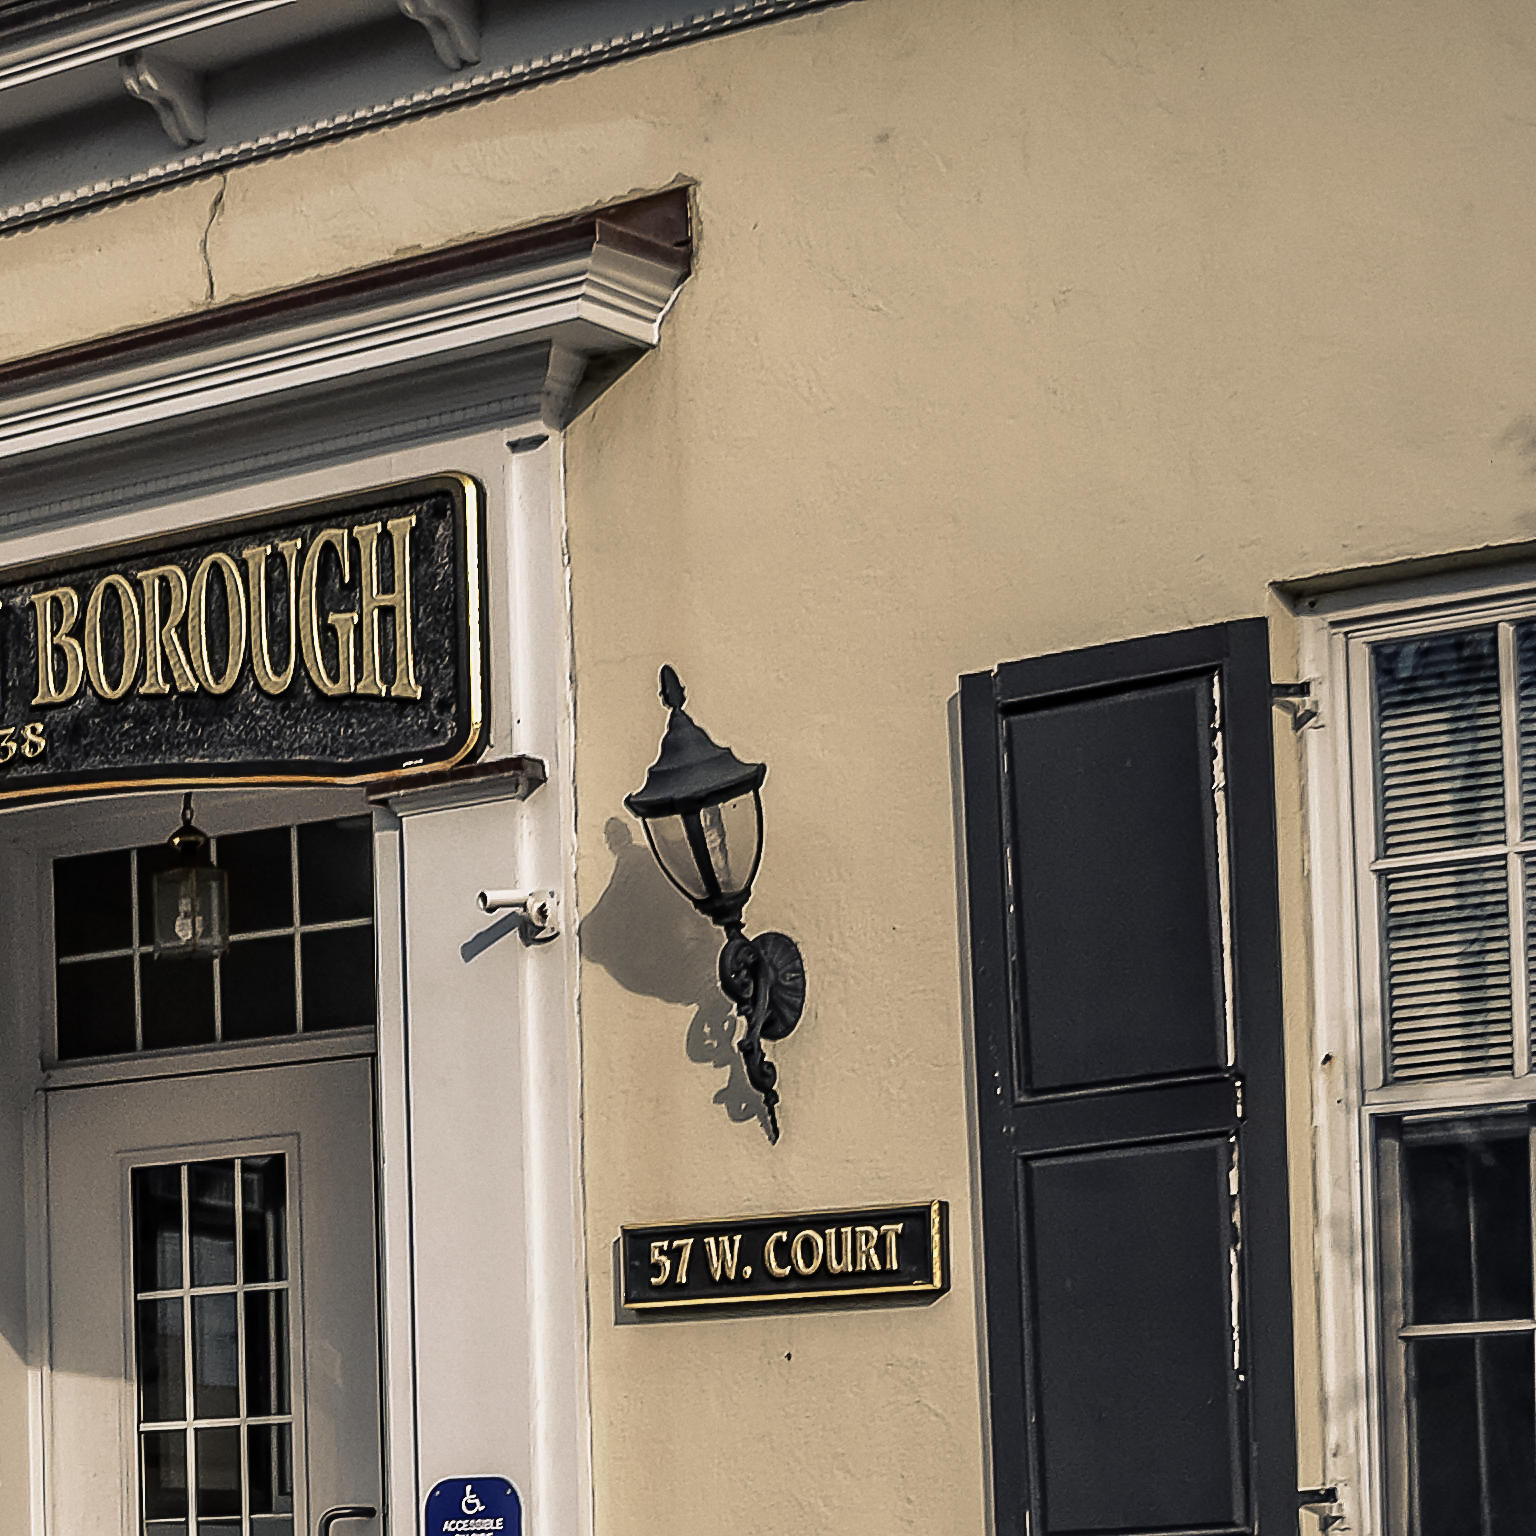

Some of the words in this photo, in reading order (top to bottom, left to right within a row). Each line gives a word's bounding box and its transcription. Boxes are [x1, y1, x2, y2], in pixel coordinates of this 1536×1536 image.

[32, 512, 424, 709] BOROUGH
[650, 1238, 695, 1286] 57
[704, 1234, 752, 1282] W.
[764, 1222, 904, 1278] COURT
